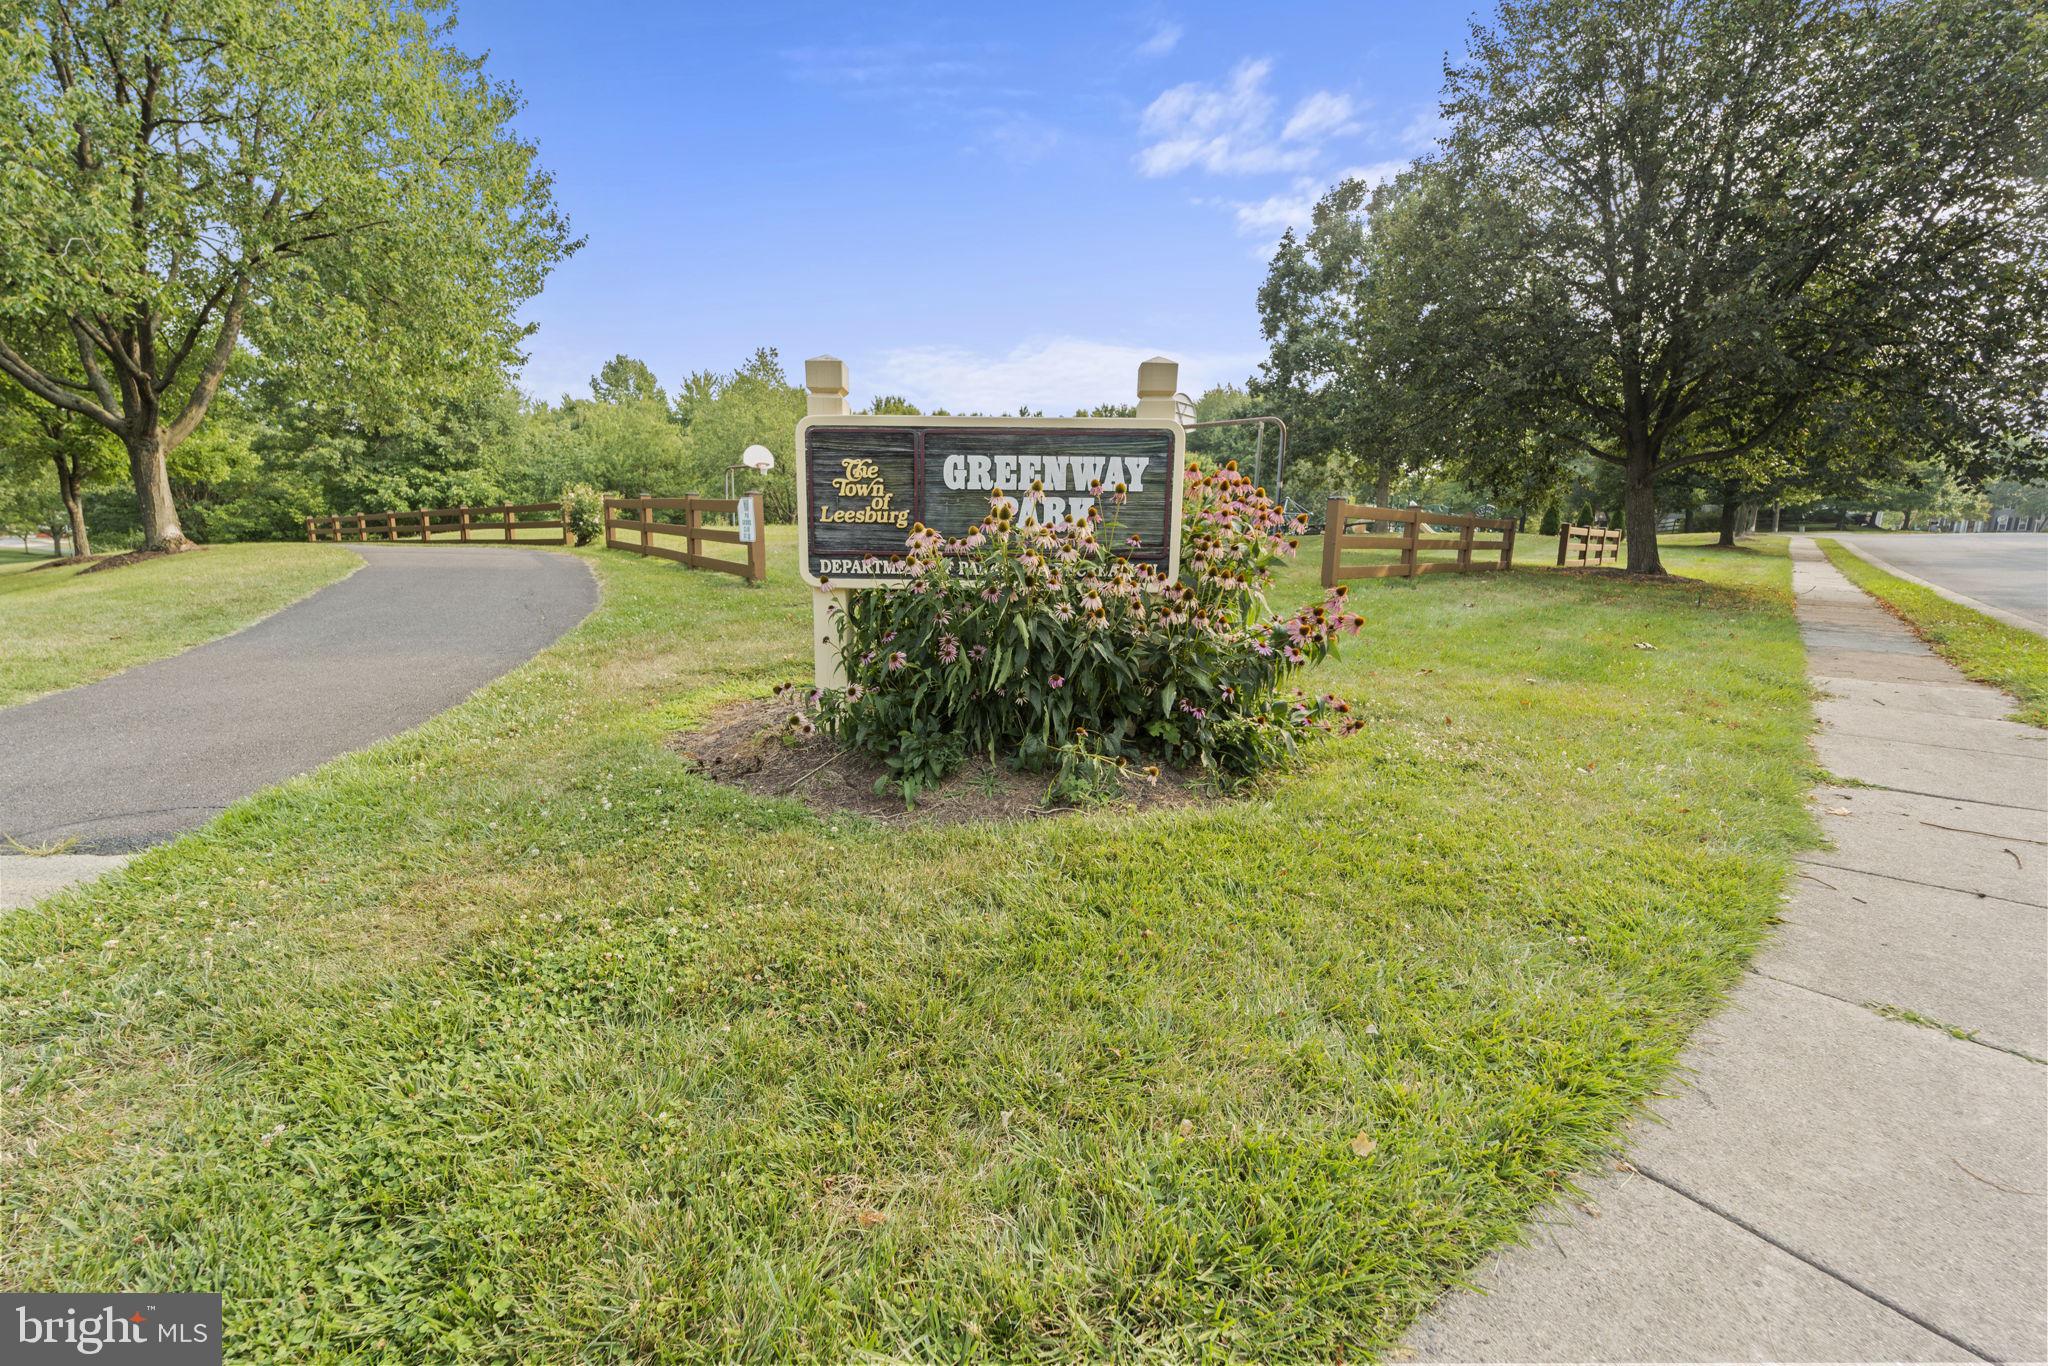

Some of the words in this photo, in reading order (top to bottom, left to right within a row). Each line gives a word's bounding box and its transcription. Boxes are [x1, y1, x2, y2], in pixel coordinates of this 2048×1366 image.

[841, 458, 879, 481] The
[943, 454, 1150, 492] GREENWAY
[832, 477, 885, 497] Town
[871, 493, 894, 510] of
[819, 505, 910, 529] Leesburg
[820, 559, 922, 575] DEPARTM
